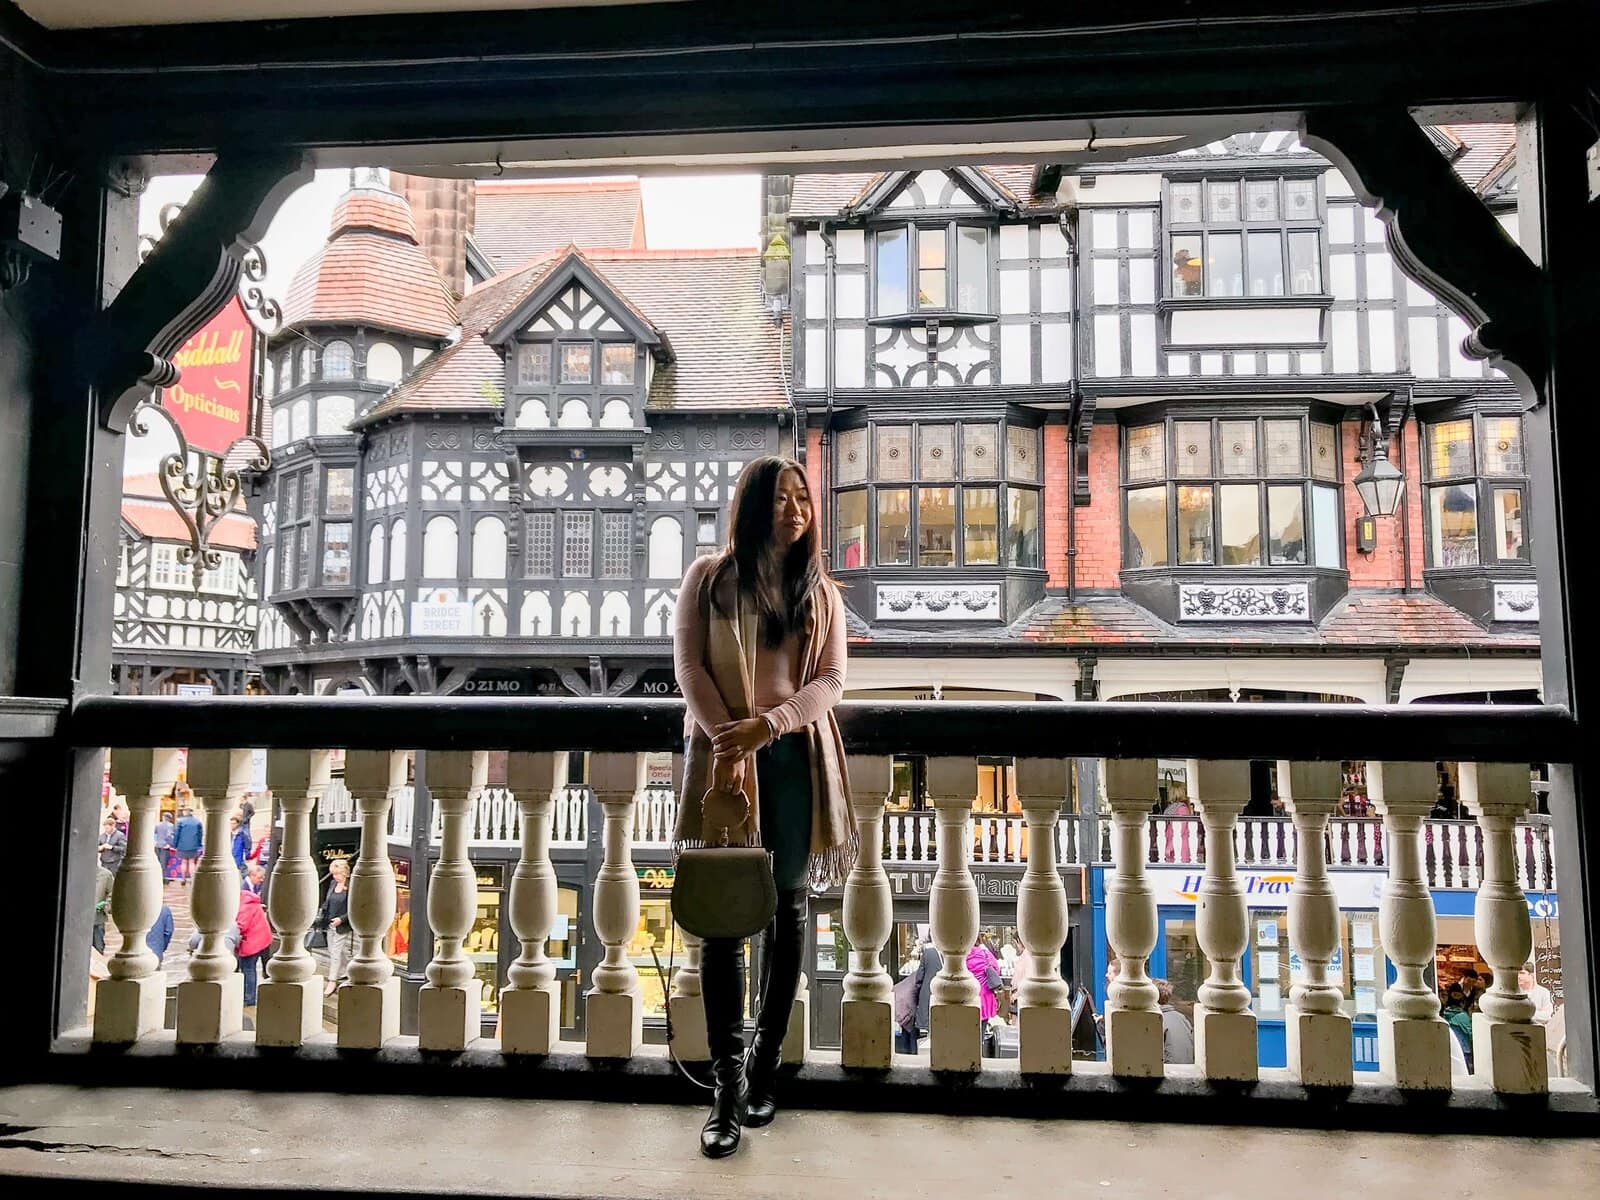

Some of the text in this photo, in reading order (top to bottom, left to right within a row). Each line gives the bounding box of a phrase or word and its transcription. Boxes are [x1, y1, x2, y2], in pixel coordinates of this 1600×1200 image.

[170, 383, 241, 424] Opticians
[423, 607, 462, 617] BRIDGE
[423, 619, 461, 631] STREET
[464, 680, 520, 692] OZIMO
[643, 682, 681, 694] MOZ
[648, 764, 672, 772] Specia
[1245, 876, 1295, 895] Trav
